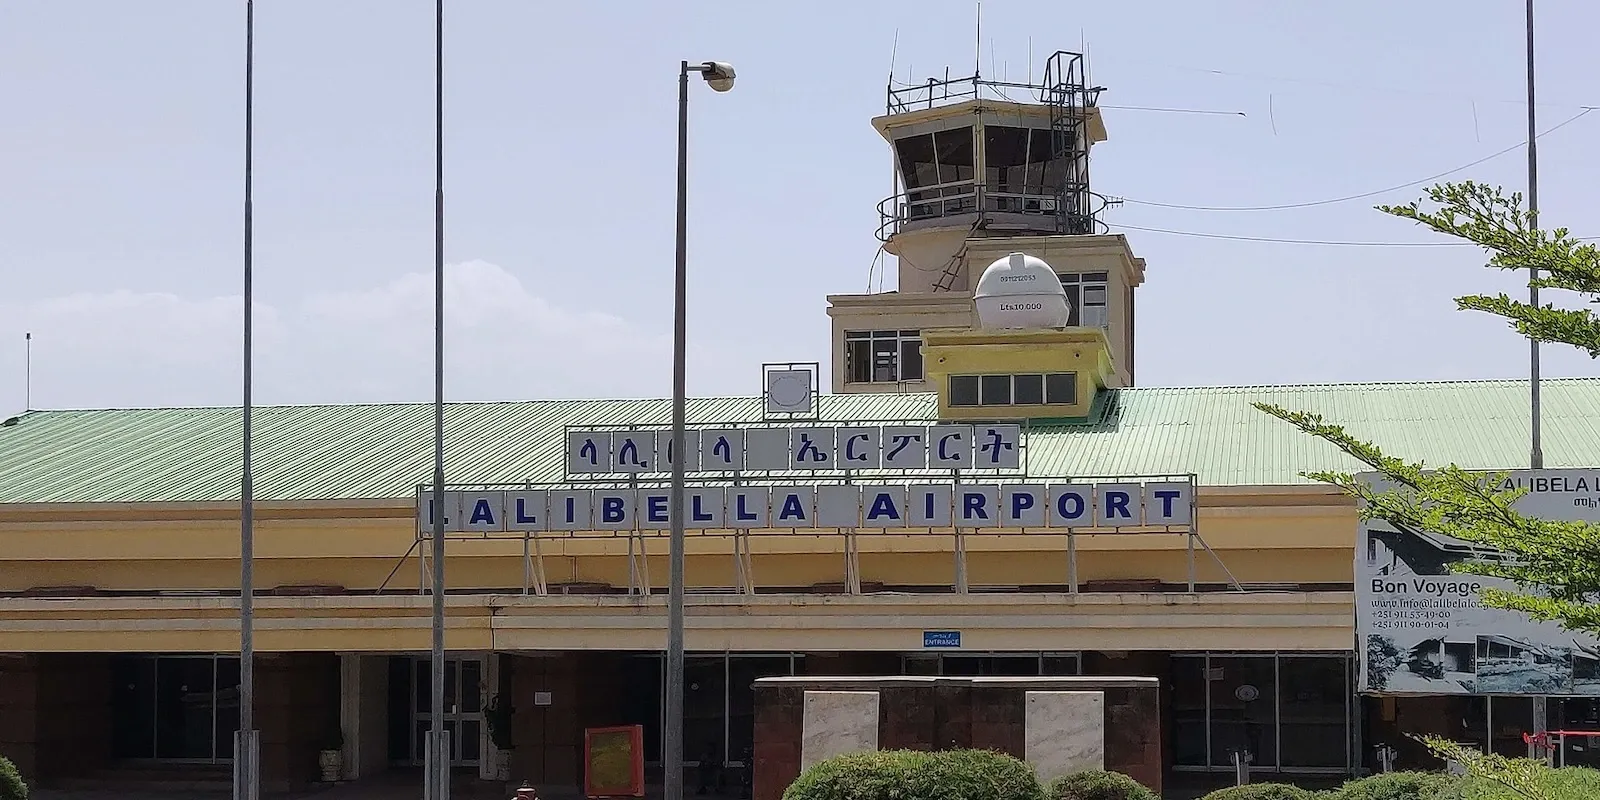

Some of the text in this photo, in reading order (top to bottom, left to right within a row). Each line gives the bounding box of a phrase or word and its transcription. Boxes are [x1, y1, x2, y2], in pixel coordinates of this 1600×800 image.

[580, 428, 1013, 468] ላሊላ ኤርፖርት
[1493, 478, 1589, 492] AIBELA
[867, 490, 1181, 519] AIRPORT
[1372, 579, 1481, 596] Bon Voyage
[1372, 611, 1392, 619] +251
[1394, 611, 1407, 619] 911
[1372, 621, 1449, 629] +251 911 90-01-04
